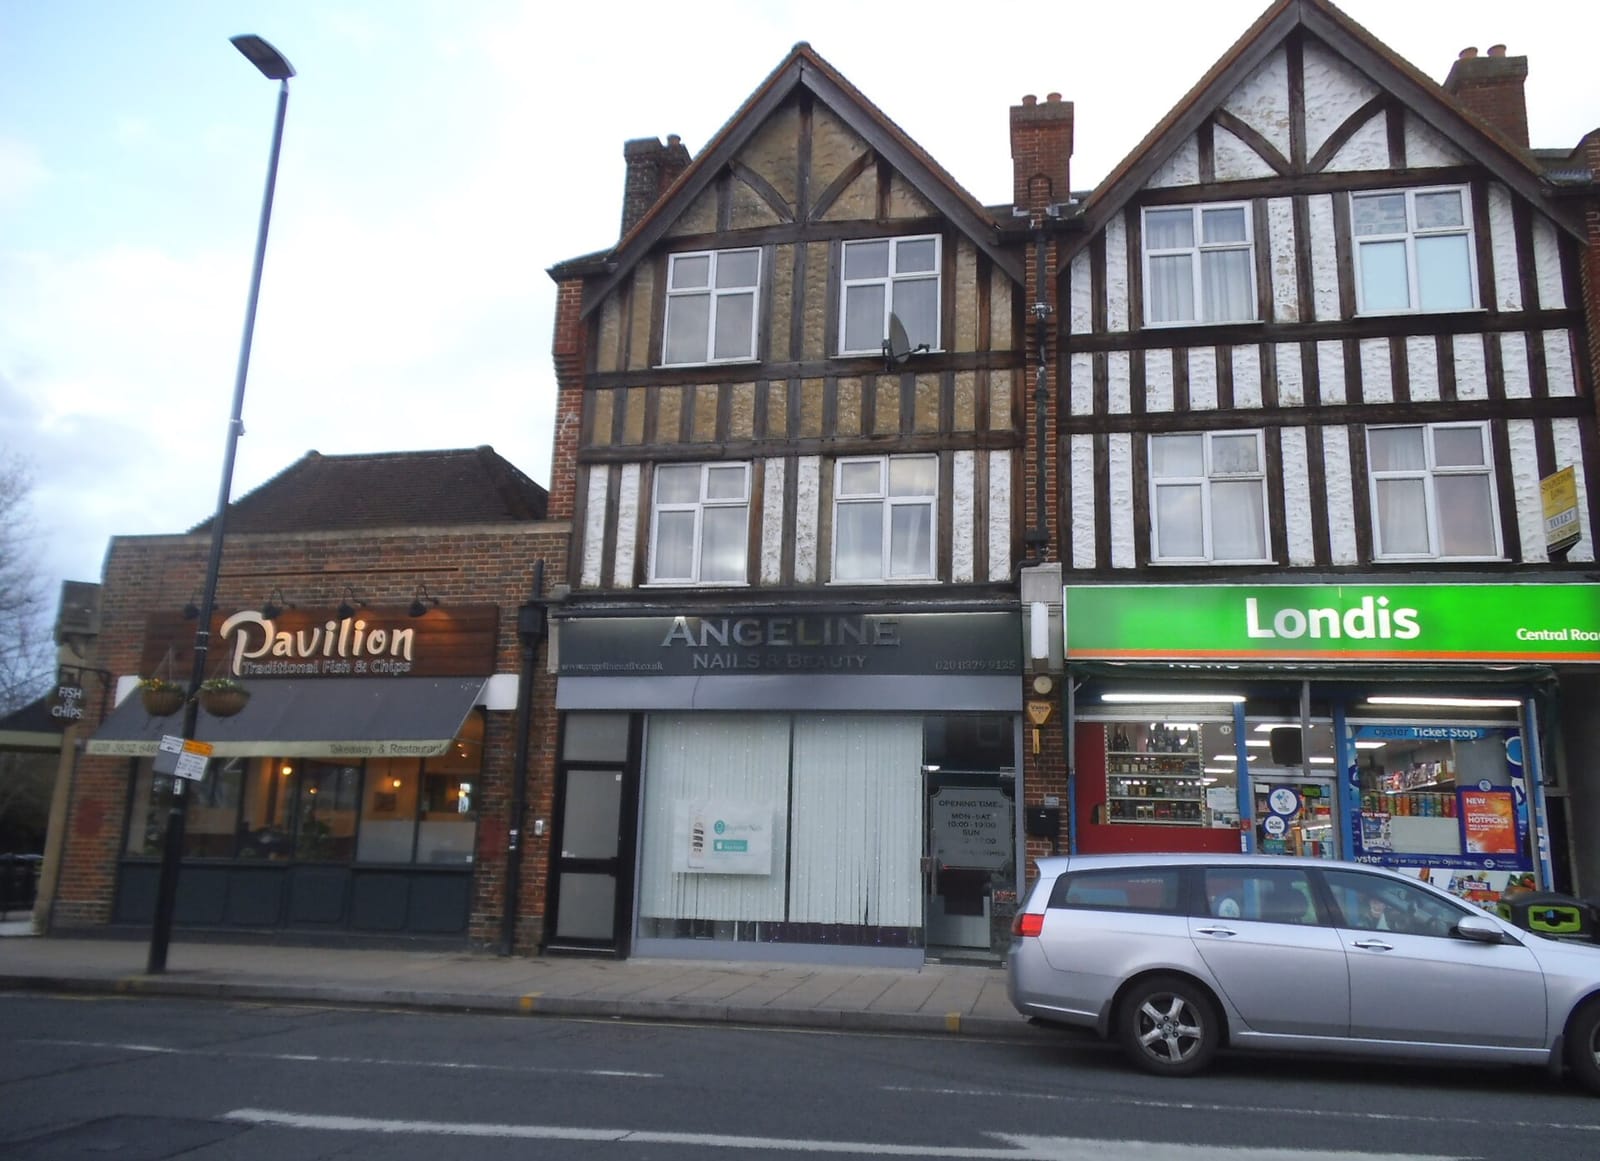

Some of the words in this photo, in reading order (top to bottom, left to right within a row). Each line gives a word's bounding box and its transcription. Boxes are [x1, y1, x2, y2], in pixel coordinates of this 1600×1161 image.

[1246, 596, 1421, 639] Londis
[1516, 628, 1568, 641] Central
[1570, 629, 1600, 641] Roa
[220, 611, 414, 676] Pavilion
[243, 661, 318, 674] Traditional
[322, 661, 350, 673] Fish
[354, 661, 367, 673] &
[371, 659, 411, 675] Chips
[693, 653, 760, 669] NAILS
[787, 654, 867, 668] BEAUTY
[58, 687, 82, 699] FISH
[52, 706, 83, 719] CHIPS
[1411, 728, 1447, 738] Ticket
[1450, 728, 1478, 739] Stop
[979, 800, 1003, 808] TIME
[1466, 797, 1486, 805] NEW
[951, 812, 970, 820] MON
[1468, 816, 1509, 825] HOTPICKS
